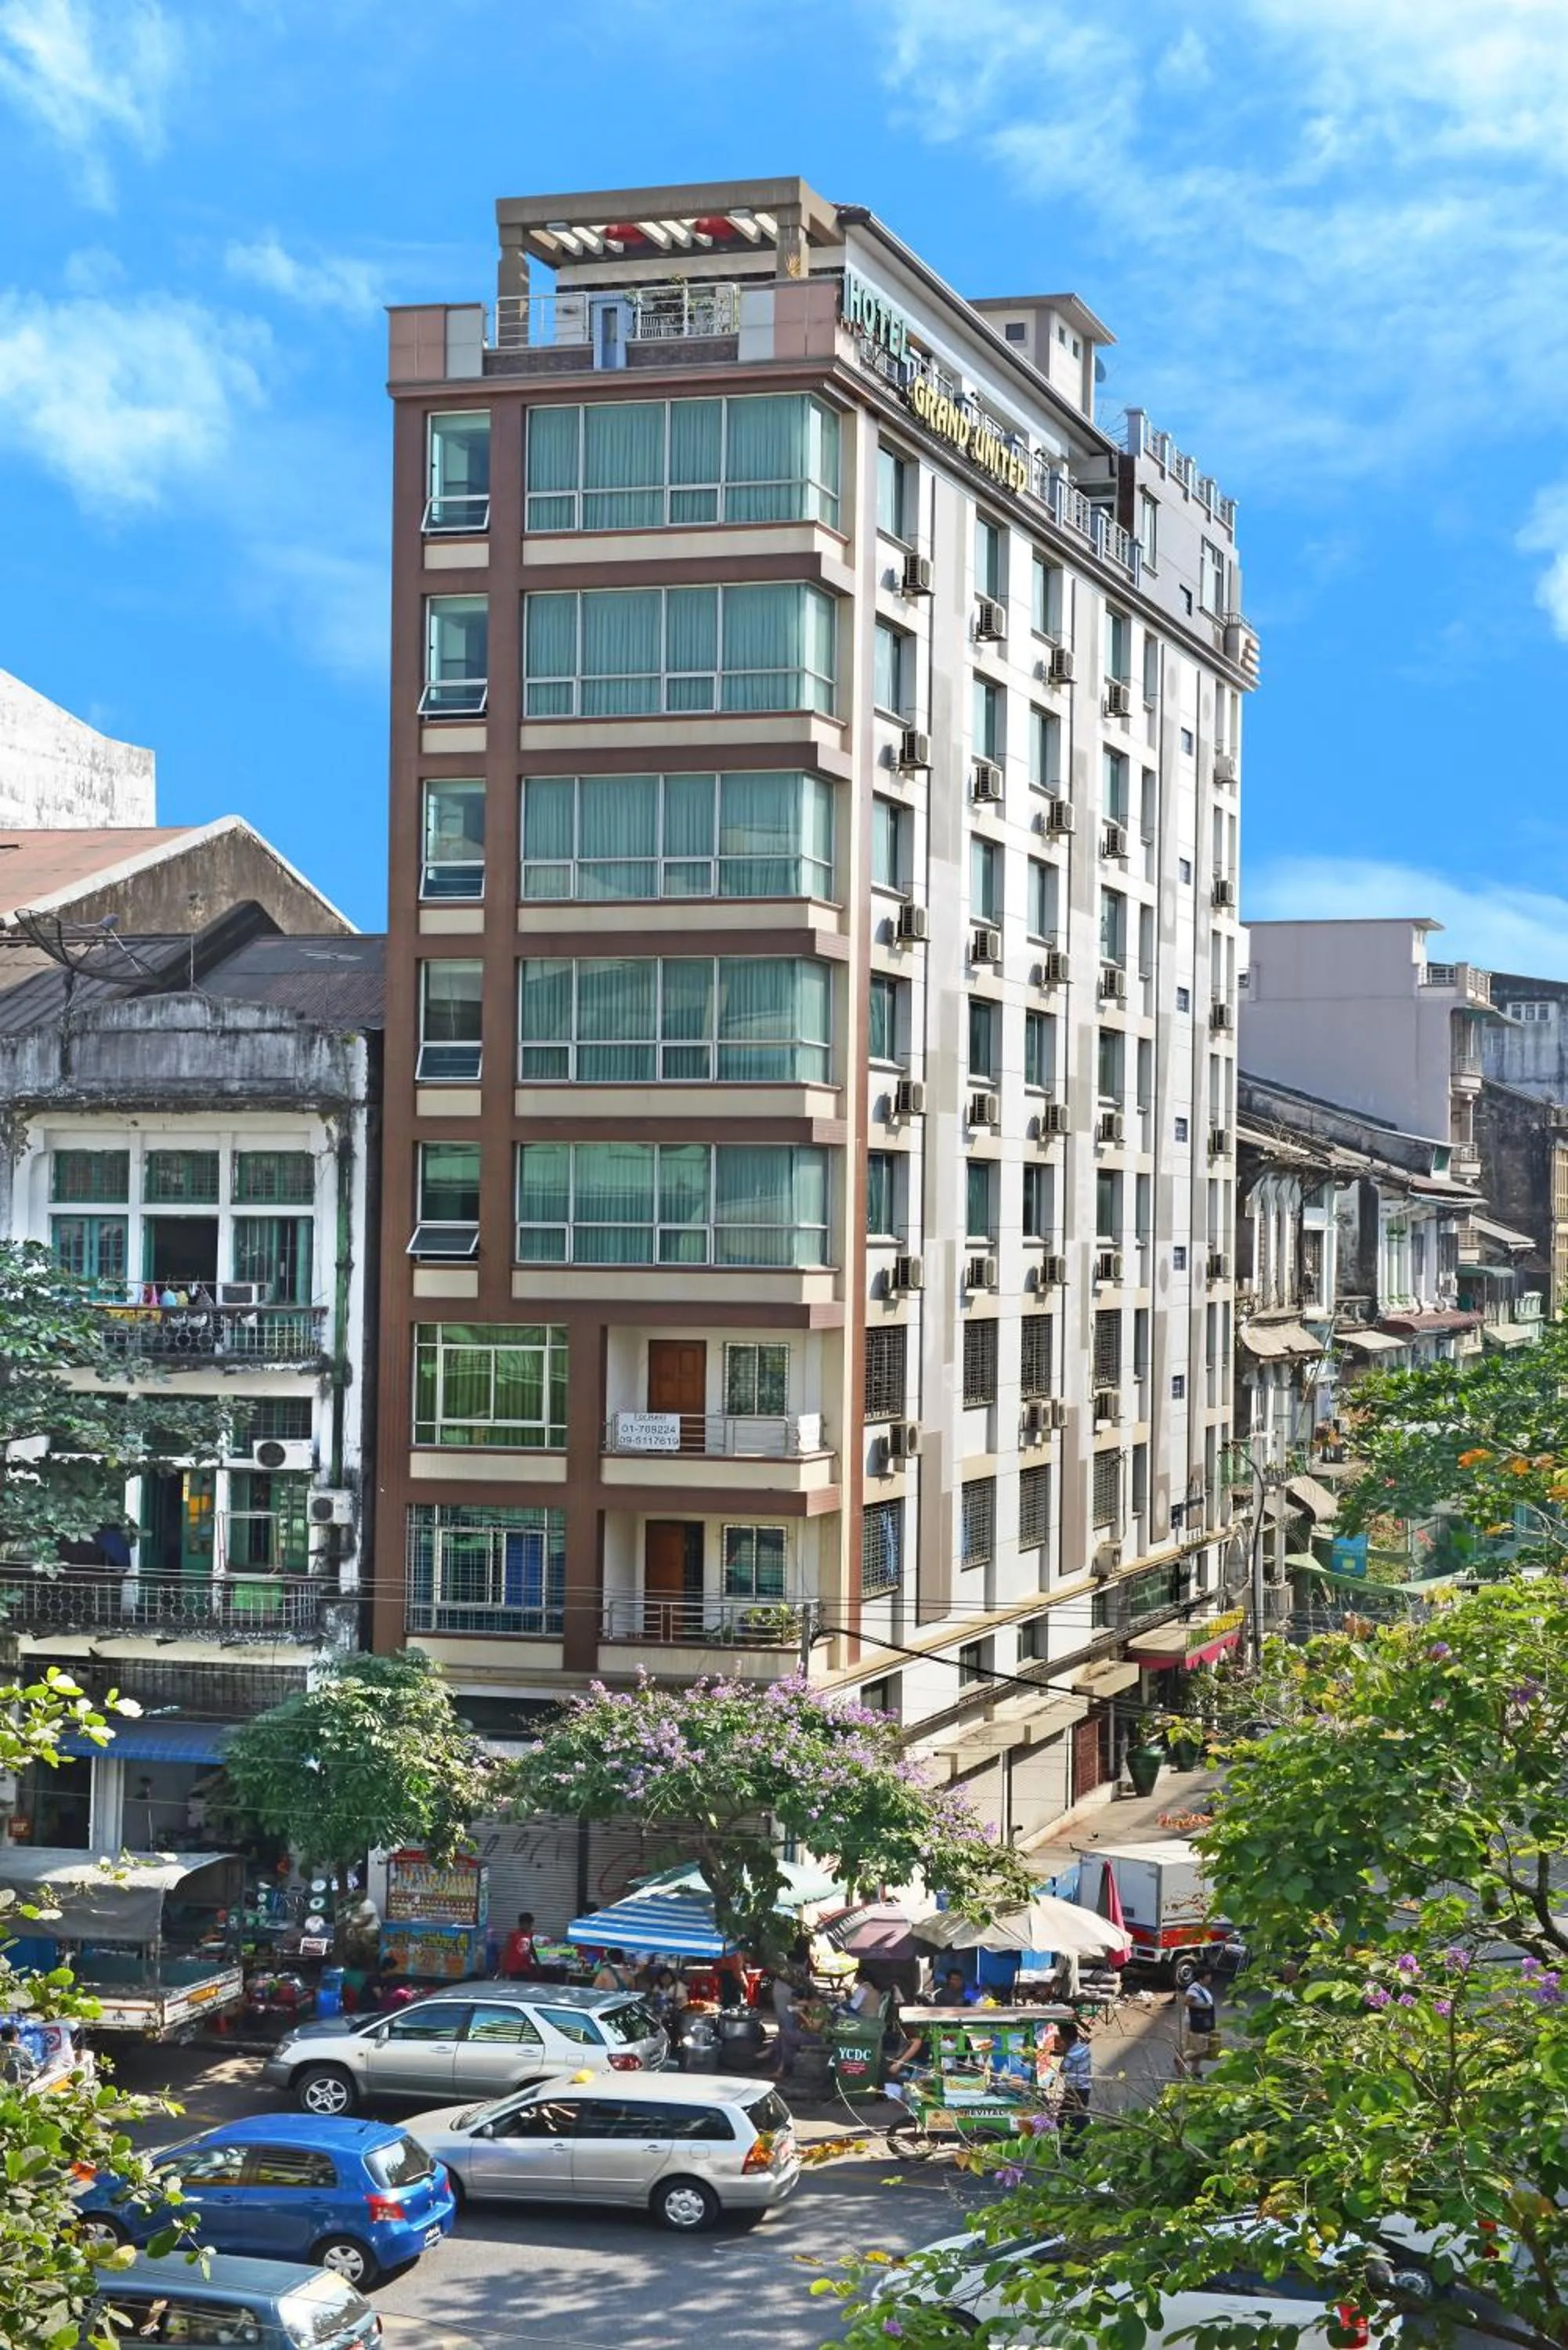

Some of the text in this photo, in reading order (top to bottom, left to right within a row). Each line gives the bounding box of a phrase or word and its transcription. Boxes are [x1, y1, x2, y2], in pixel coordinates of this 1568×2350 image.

[845, 273, 909, 364] HOTEL
[914, 376, 1027, 492] GRAND UNITED
[839, 2047, 872, 2061] YCDC
